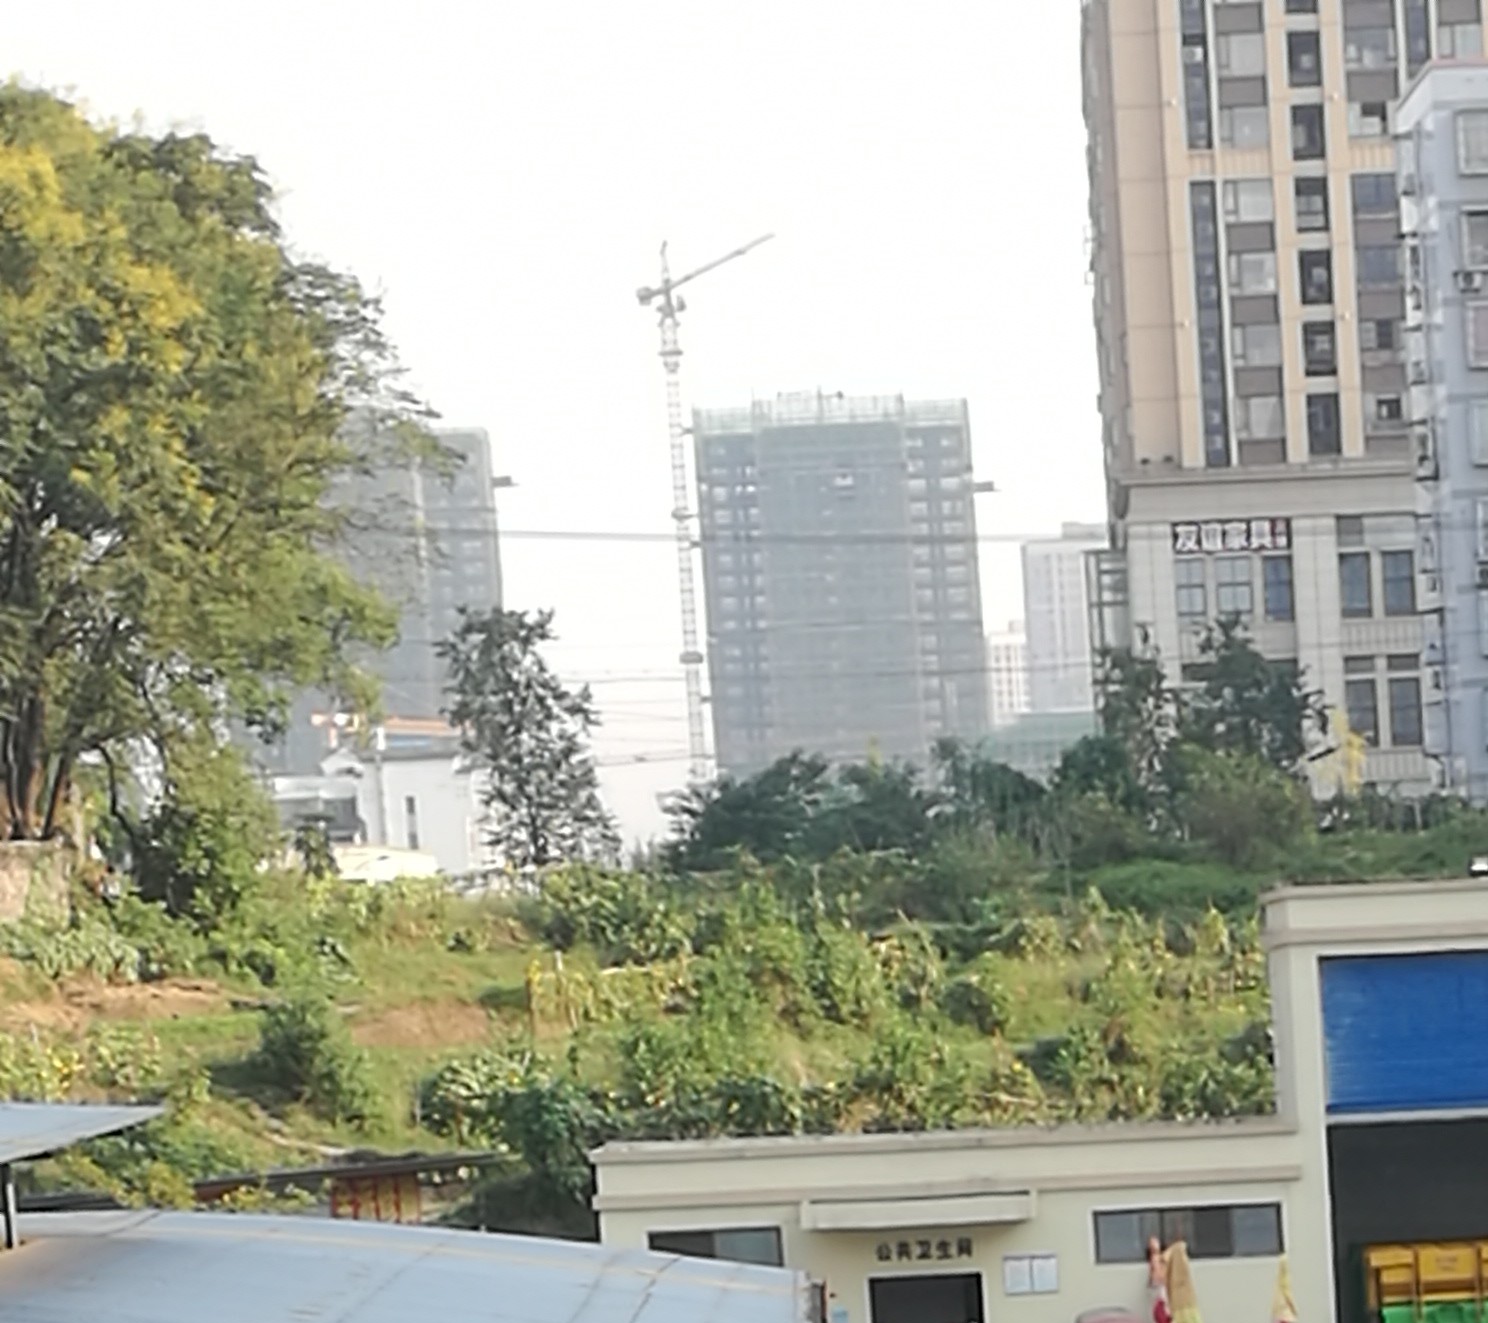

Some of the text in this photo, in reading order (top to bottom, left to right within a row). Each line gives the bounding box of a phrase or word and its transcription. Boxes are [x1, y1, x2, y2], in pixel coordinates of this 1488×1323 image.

[876, 1237, 973, 1262] 公共卫生间
